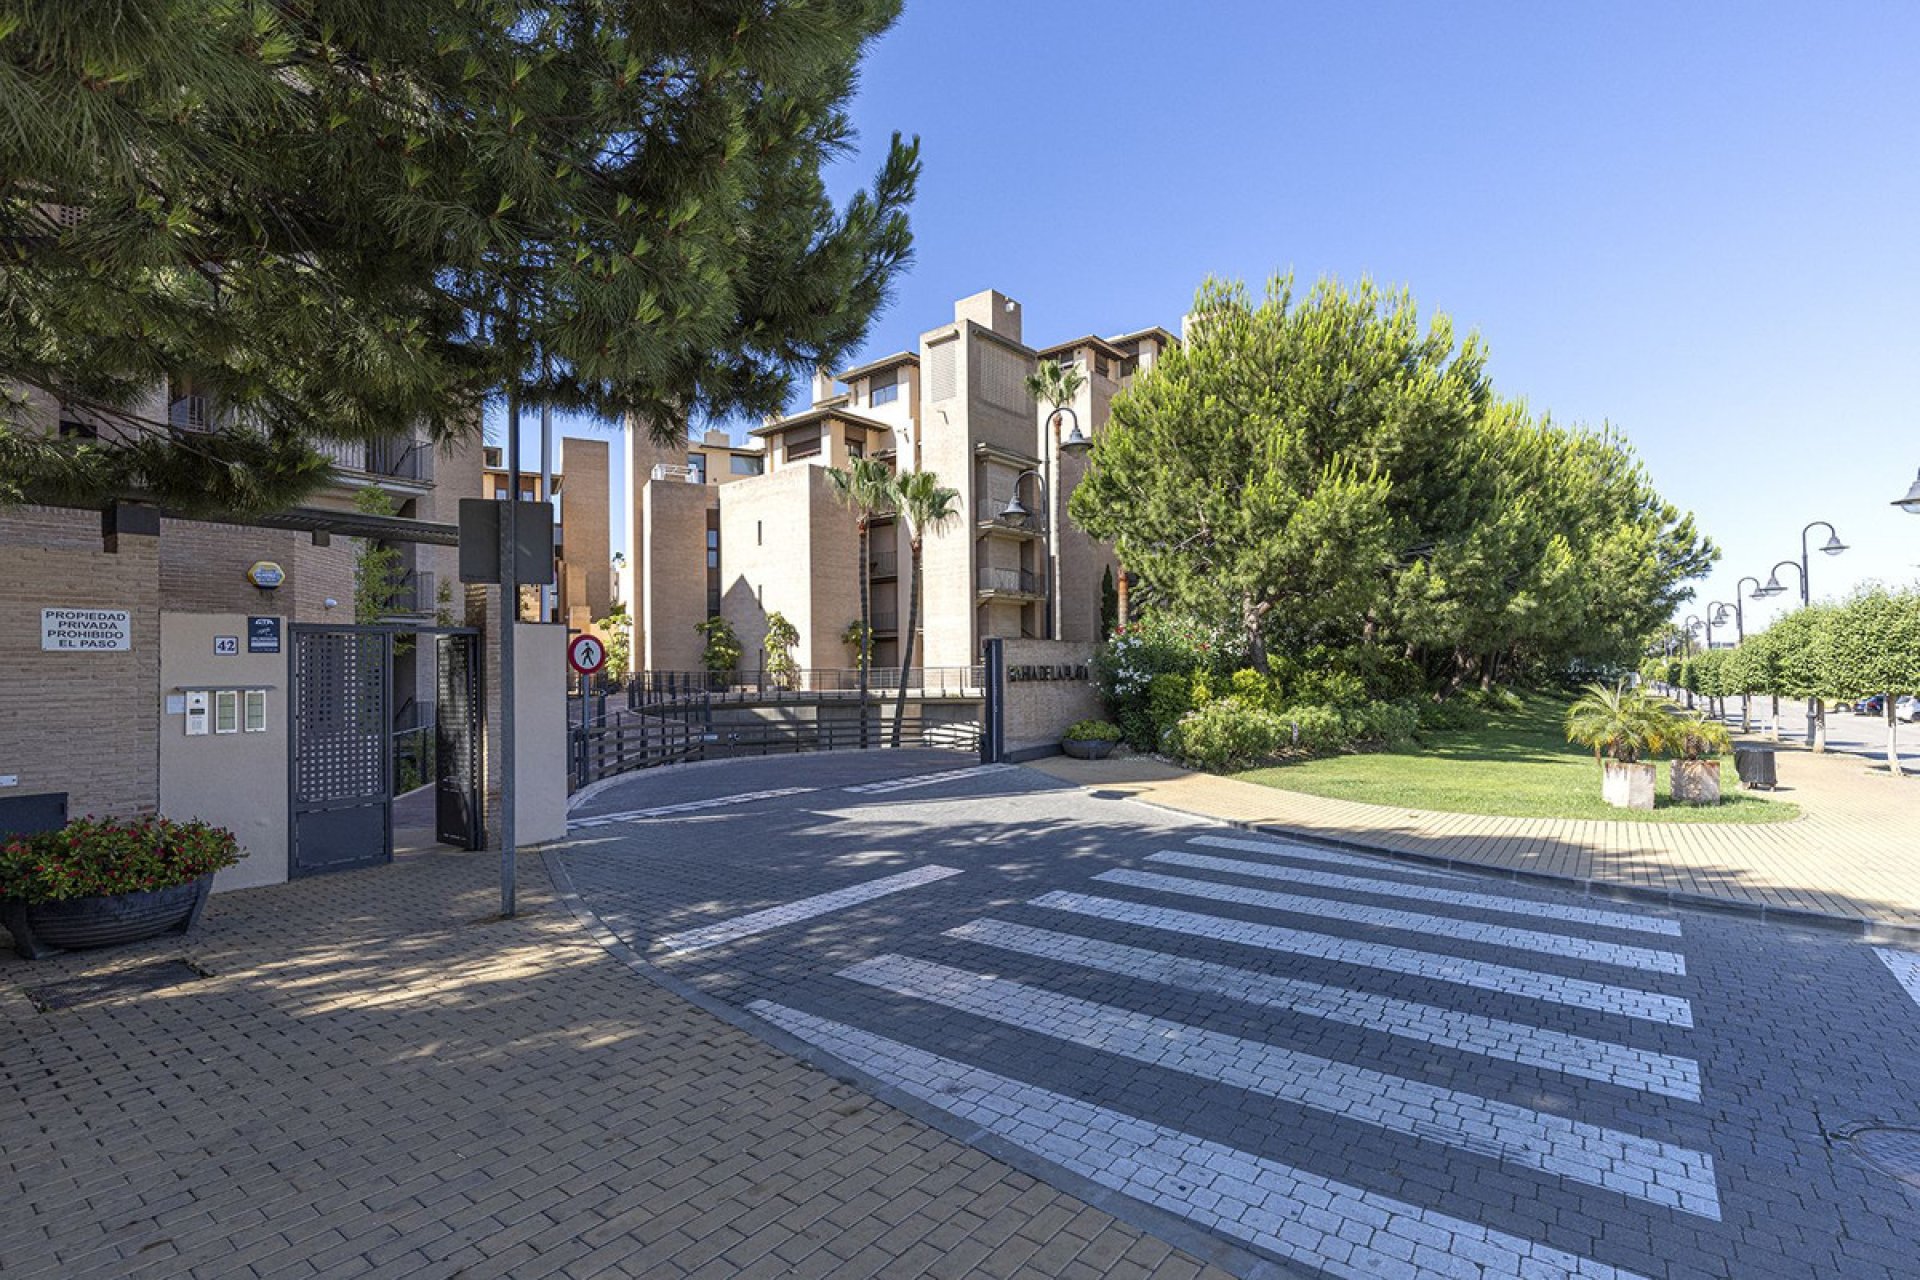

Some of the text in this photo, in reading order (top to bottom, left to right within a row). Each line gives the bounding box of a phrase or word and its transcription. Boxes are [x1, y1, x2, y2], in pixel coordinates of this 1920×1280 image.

[45, 611, 126, 621] PROPIEDAD
[58, 620, 118, 630] PRIVADA
[47, 629, 124, 639] PROHIBIDO
[59, 639, 118, 648] EL PASO
[217, 639, 235, 652] 42
